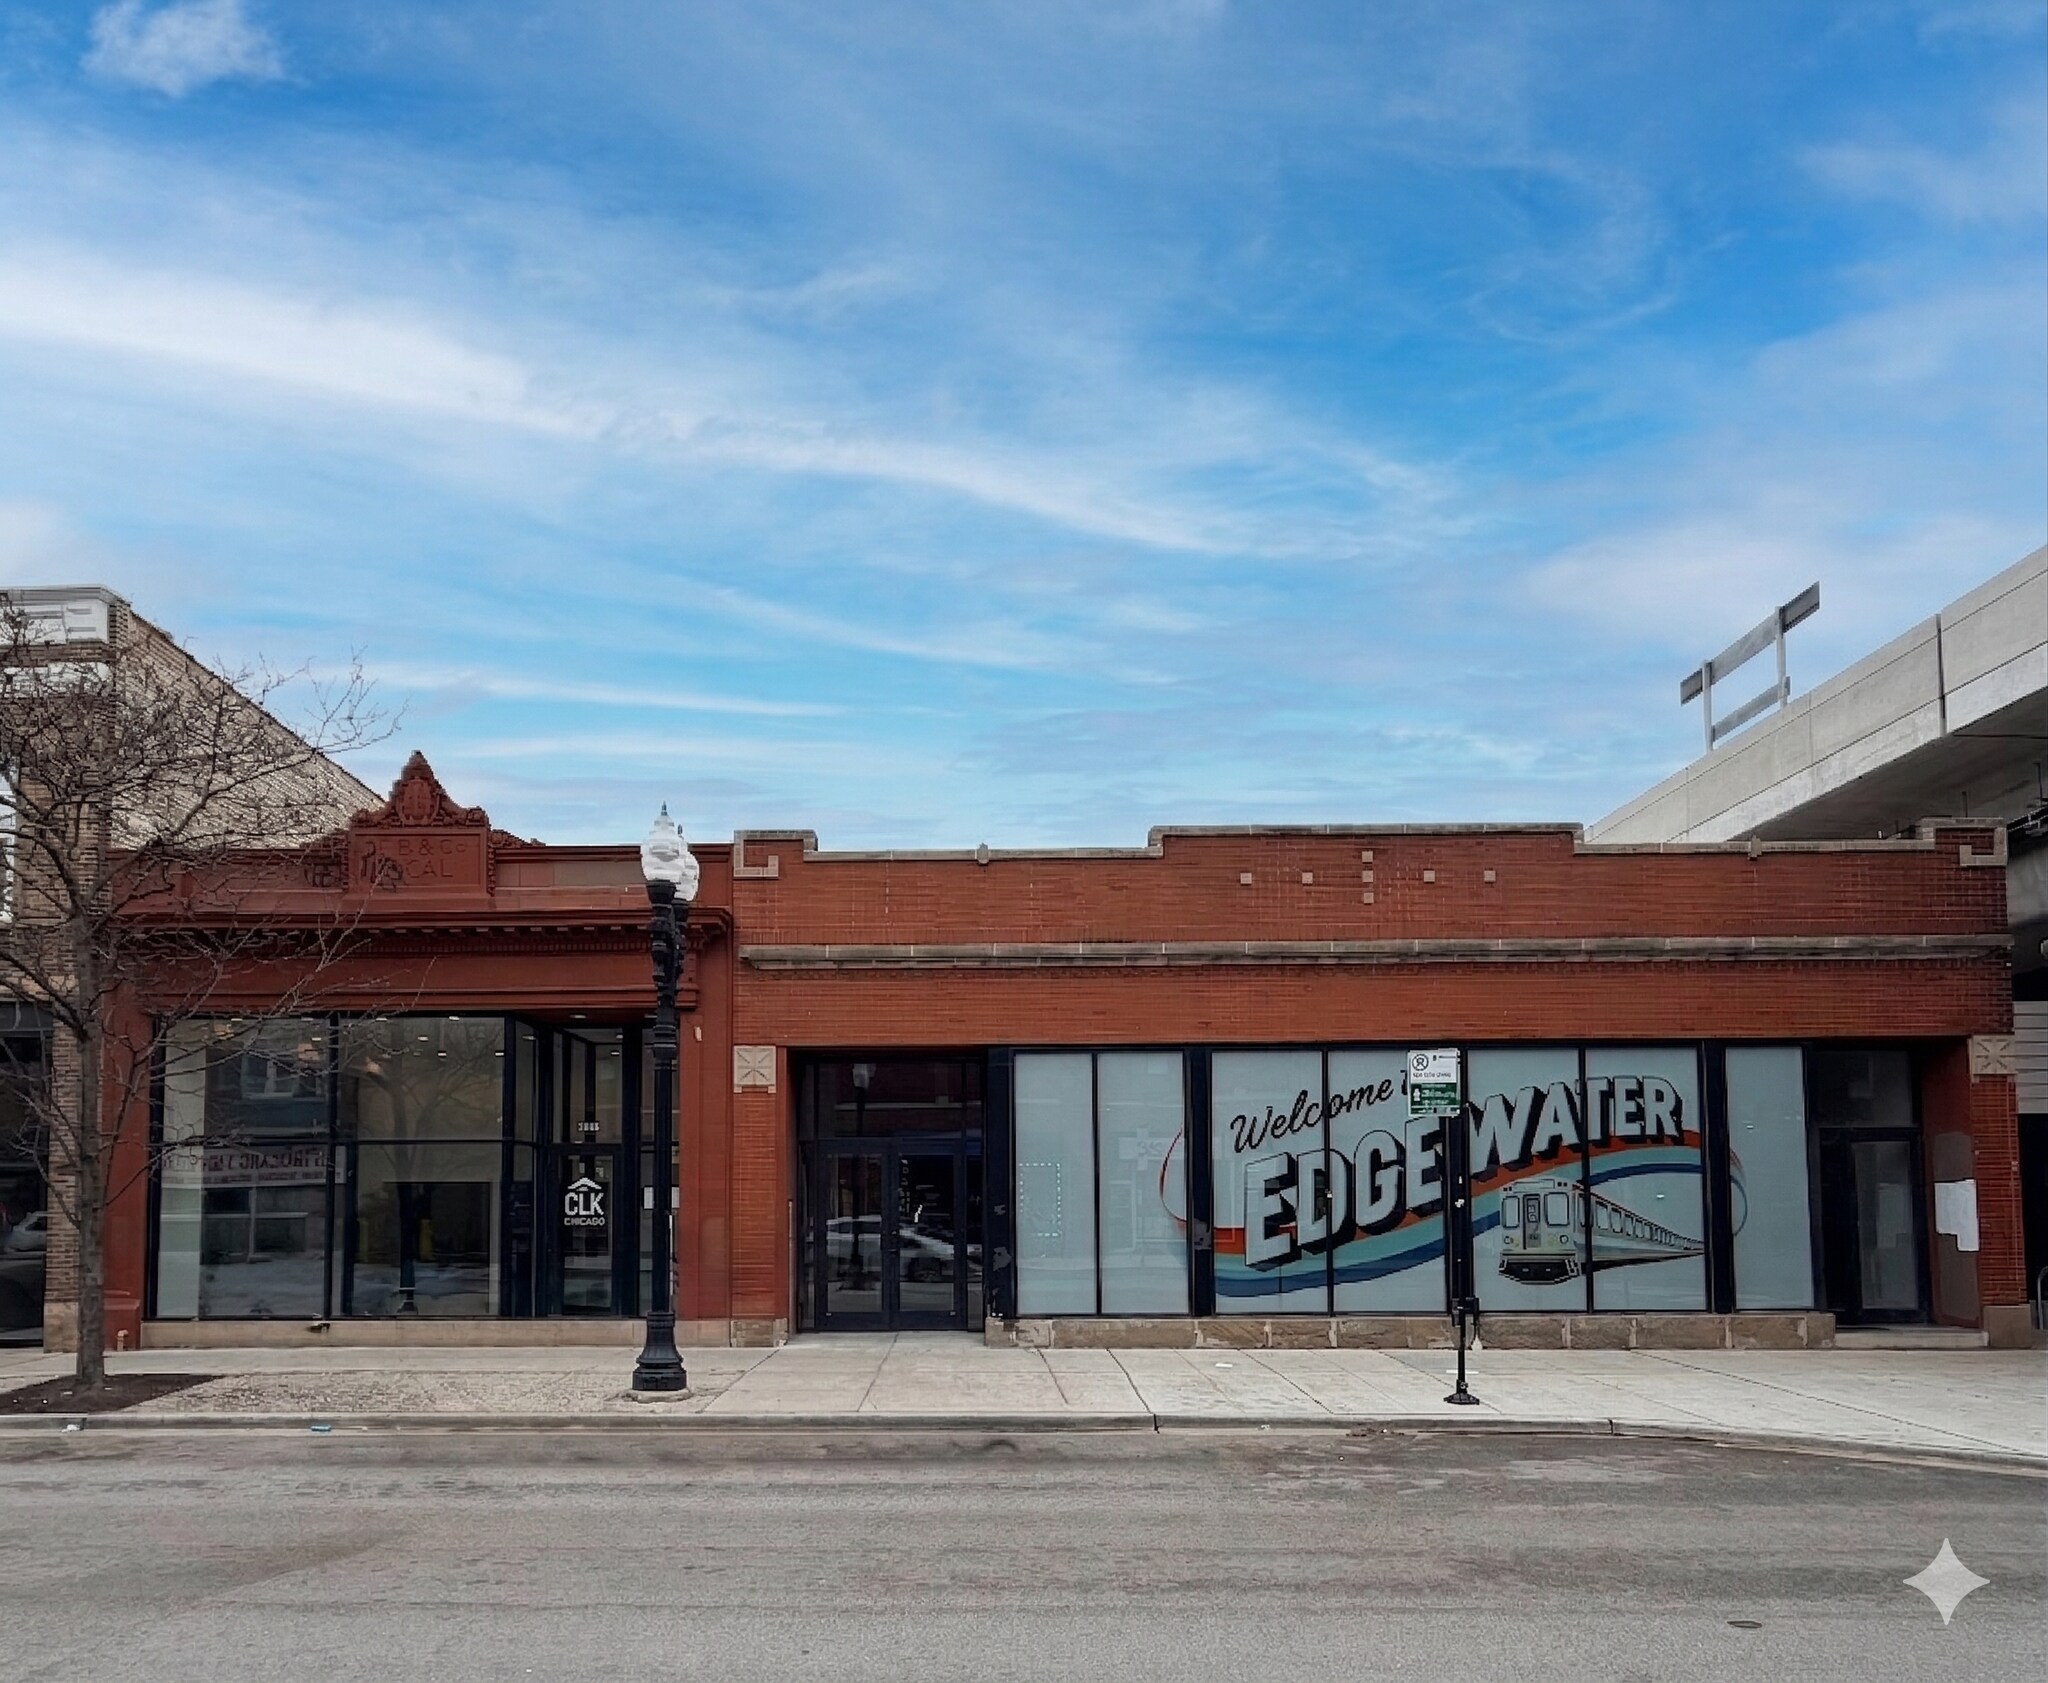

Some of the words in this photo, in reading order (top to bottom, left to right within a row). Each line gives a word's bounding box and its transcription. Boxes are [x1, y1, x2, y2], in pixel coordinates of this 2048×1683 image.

[1230, 1078, 1395, 1153] Welcome
[1244, 1075, 1685, 1272] EDGEWATER
[563, 1217, 606, 1226] CHICAGO
[564, 1191, 605, 1216] CLK
